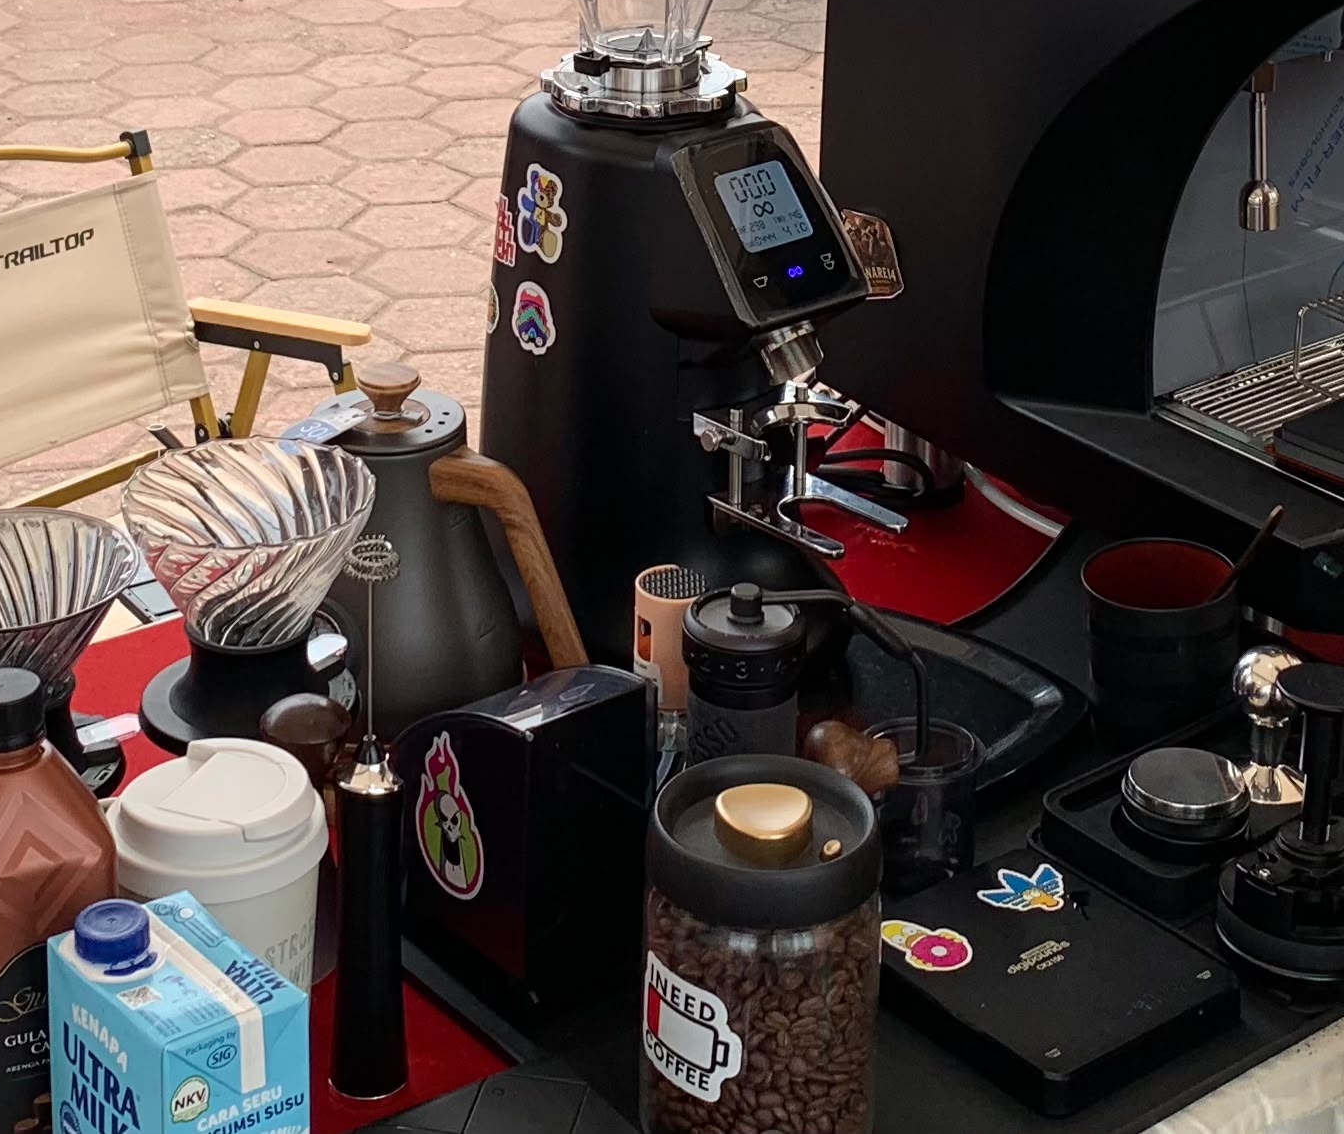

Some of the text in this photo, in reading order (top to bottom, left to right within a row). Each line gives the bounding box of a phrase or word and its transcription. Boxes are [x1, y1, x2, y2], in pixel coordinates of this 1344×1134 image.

[224, 959, 274, 1005] ULTRA
[656, 970, 716, 1022] NEED
[4, 1028, 47, 1048] GULA
[71, 1002, 128, 1075] KENAPA
[186, 1033, 225, 1057] Packaging
[211, 1047, 232, 1066] SIG
[645, 1028, 711, 1092] COFFEE
[63, 1020, 141, 1131] ULTRA
[174, 1087, 206, 1112] NKV
[197, 1085, 283, 1132] CARA SERU
[264, 1092, 305, 1120] SUSU
